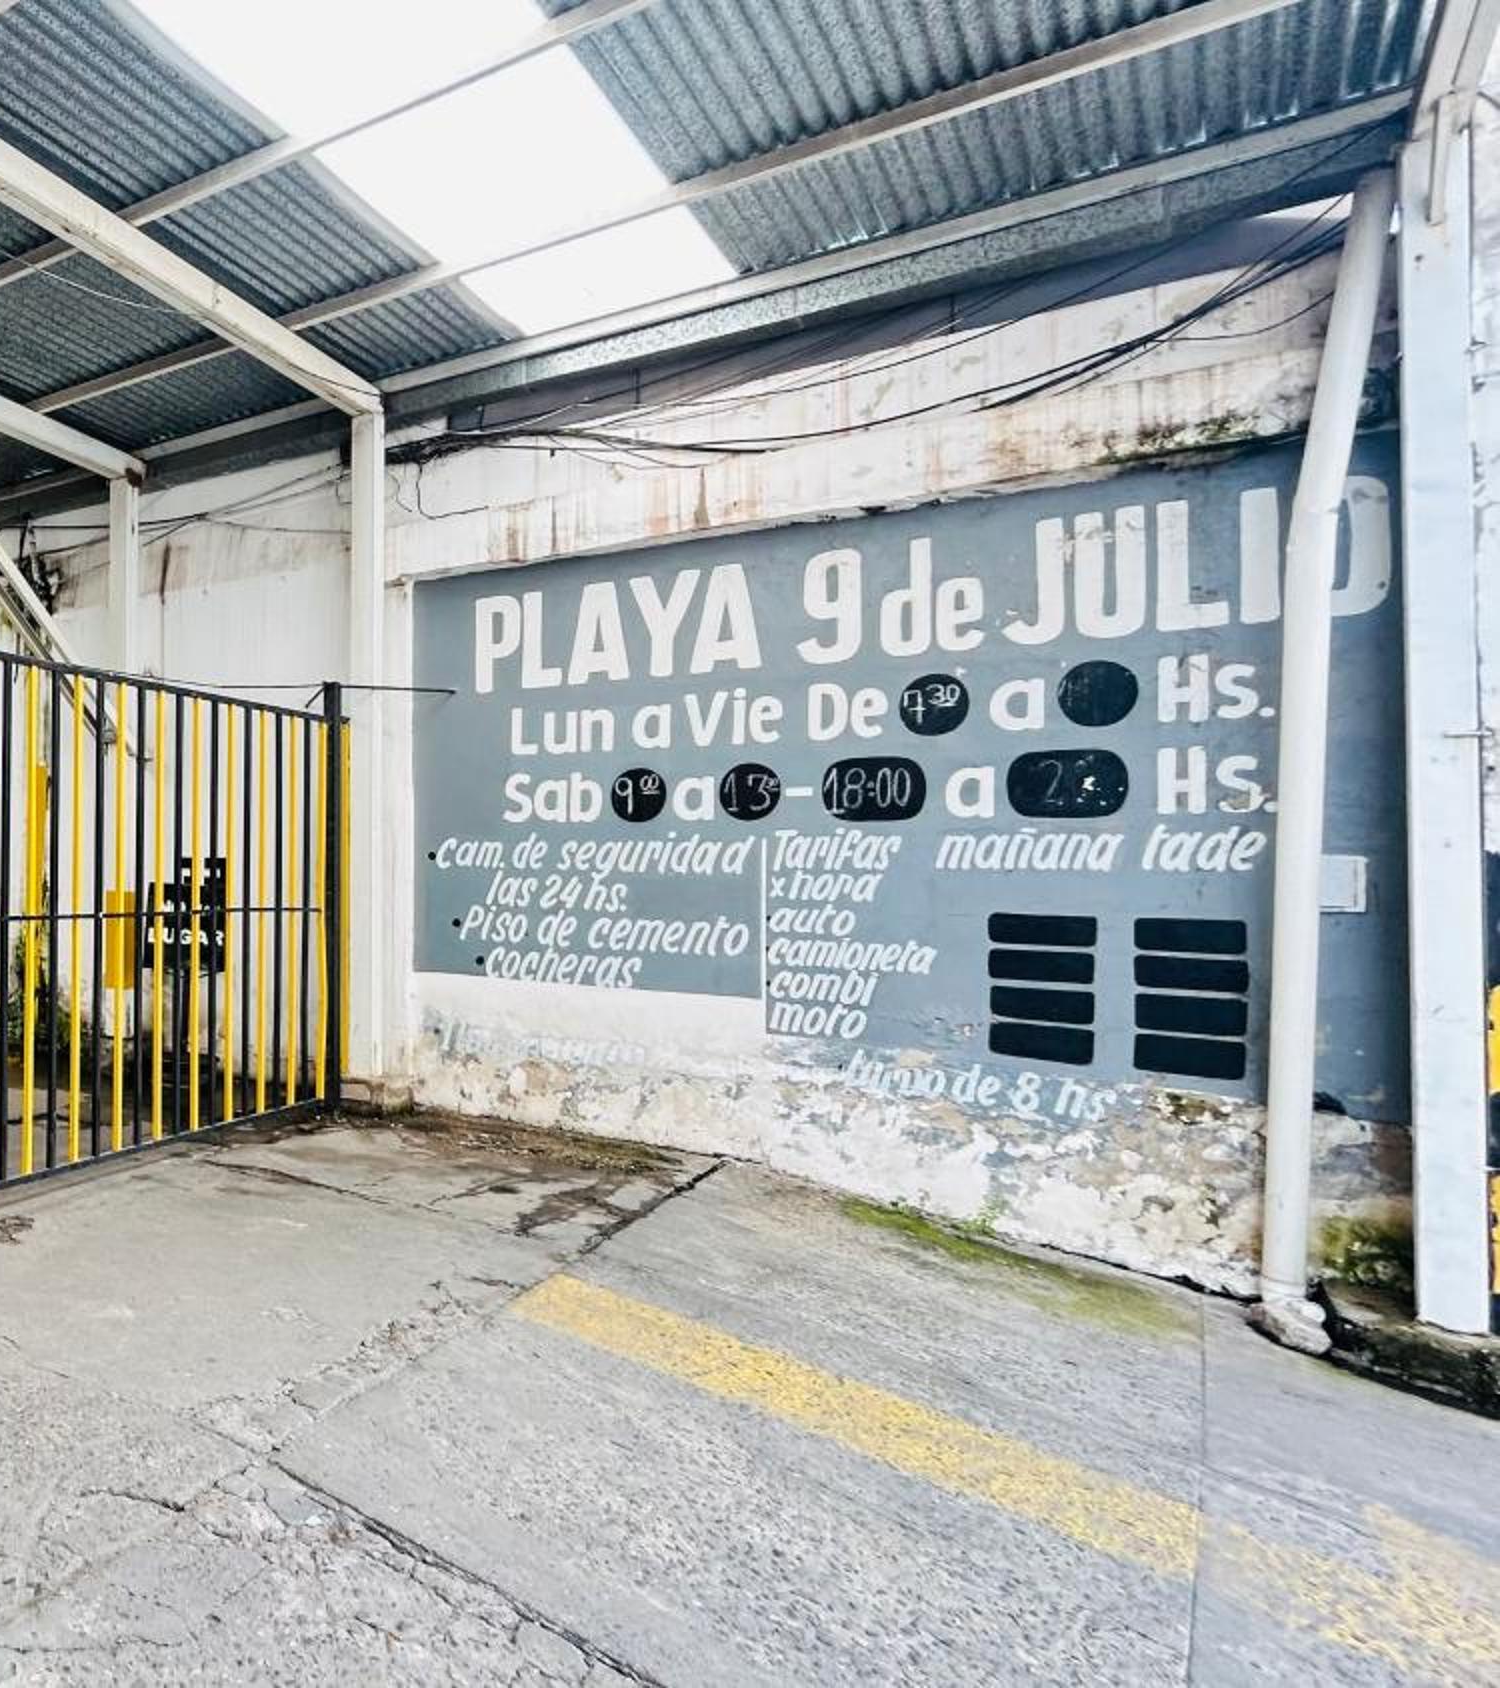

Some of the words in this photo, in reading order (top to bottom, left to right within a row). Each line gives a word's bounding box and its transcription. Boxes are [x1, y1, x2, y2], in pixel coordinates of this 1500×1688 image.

[475, 563, 762, 694] PLAYA
[797, 548, 862, 664] 9
[880, 537, 984, 657] de
[510, 707, 615, 755] Lun
[631, 703, 672, 750] a
[684, 687, 784, 748] Vie
[807, 683, 889, 741] De
[990, 678, 1045, 731] a
[1156, 653, 1276, 723] Hs.
[502, 771, 602, 824] Sab
[673, 776, 715, 821] a
[824, 767, 911, 814] 18:00
[945, 765, 995, 818] a
[1156, 745, 1277, 815] Hs.
[512, 832, 548, 869] de
[557, 831, 755, 876] seguridad
[773, 828, 901, 871] Tarifas
[935, 828, 1123, 872] mañana
[1142, 824, 1266, 871] tade
[486, 870, 538, 907] las
[539, 873, 583, 909] 24
[583, 872, 627, 912] hs.
[788, 870, 883, 902] hora
[459, 904, 528, 943] Piso
[537, 910, 577, 947] de
[588, 916, 749, 956] cemento
[770, 904, 855, 936] auto
[485, 946, 642, 988] cocheras
[768, 938, 937, 975] camioneta
[769, 969, 880, 1006] combi
[770, 1001, 866, 1038] moto
[952, 1063, 1000, 1105] de
[1011, 1071, 1041, 1113] 8
[1054, 1077, 1117, 1122] hs
